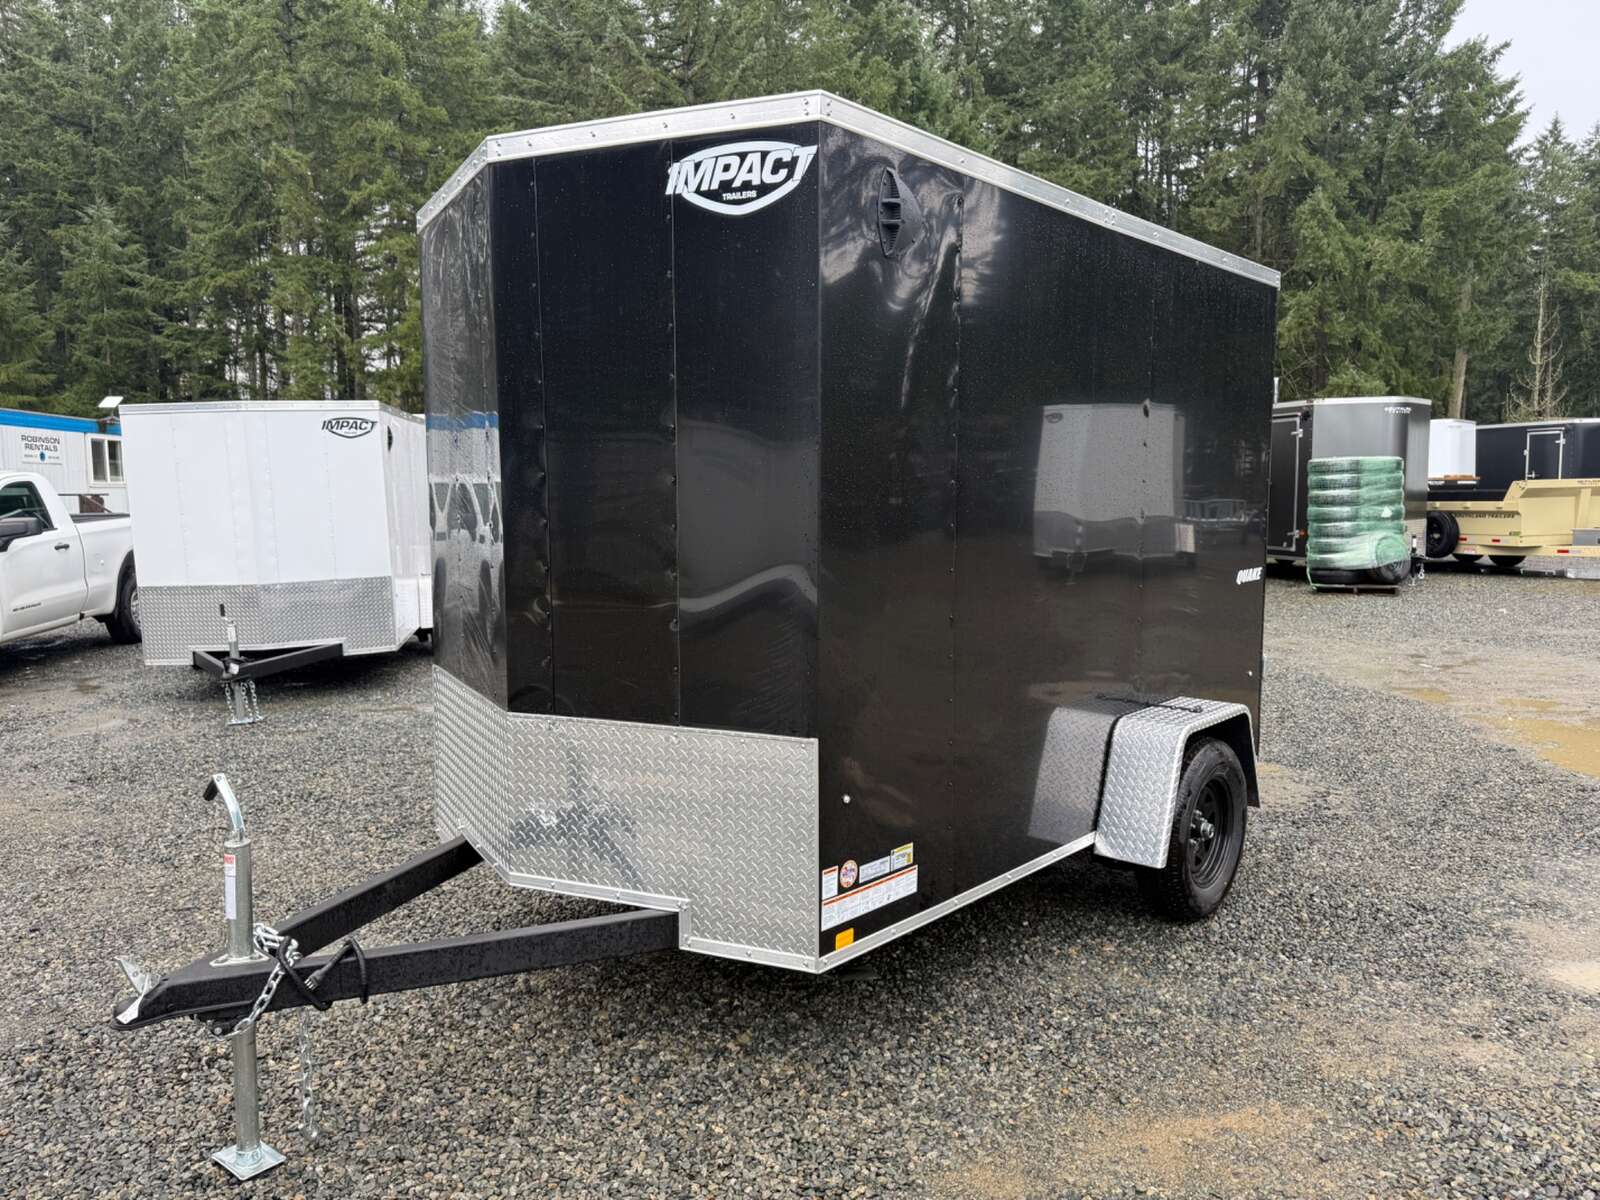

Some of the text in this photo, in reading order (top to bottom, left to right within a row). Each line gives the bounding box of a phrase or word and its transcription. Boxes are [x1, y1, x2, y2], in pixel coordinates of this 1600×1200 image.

[665, 145, 818, 195] IMPACT
[722, 190, 758, 200] TRAILERS
[321, 420, 377, 430] IMPACT
[21, 435, 60, 444] ROBINSON
[24, 443, 58, 451] RENTALS
[1236, 566, 1262, 584] QUAKE
